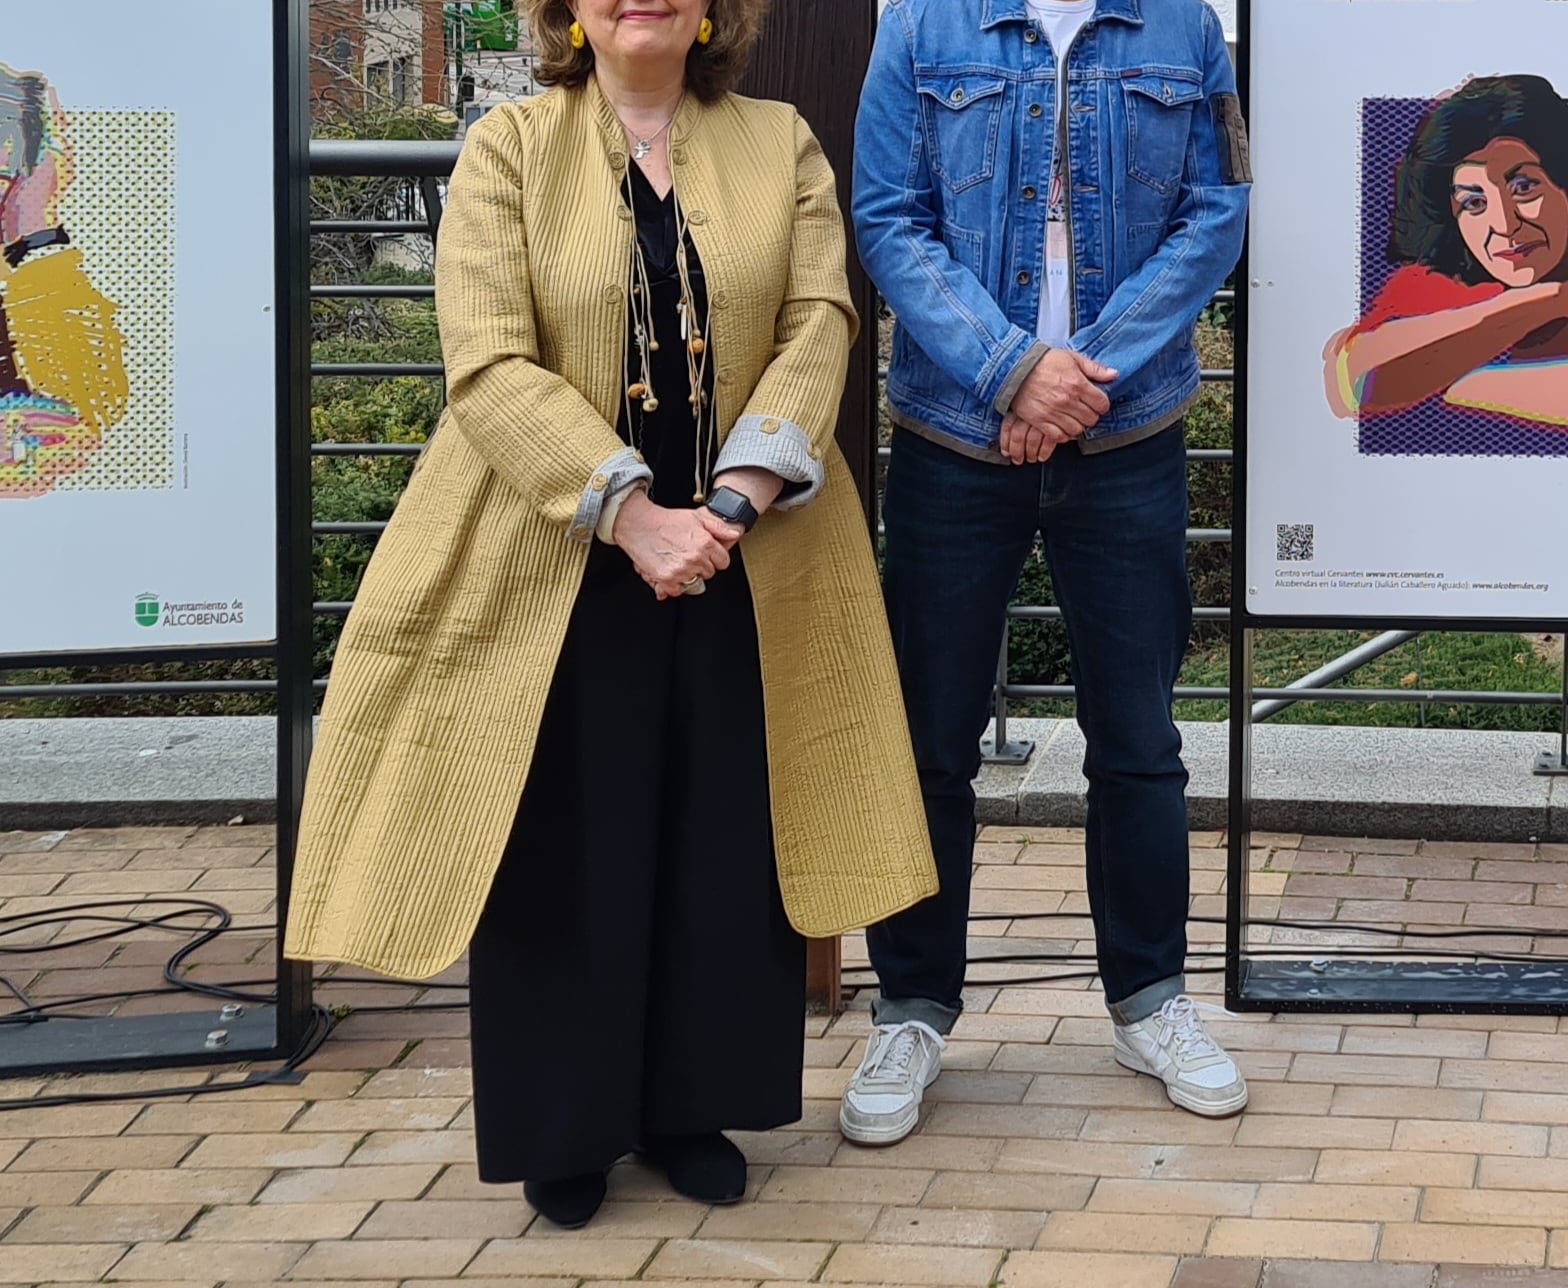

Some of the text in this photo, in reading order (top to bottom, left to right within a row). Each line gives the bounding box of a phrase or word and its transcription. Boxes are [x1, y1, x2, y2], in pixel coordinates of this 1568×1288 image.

[162, 599, 243, 614] Ayuntamiento de
[162, 612, 244, 626] ALCOBENDAS
